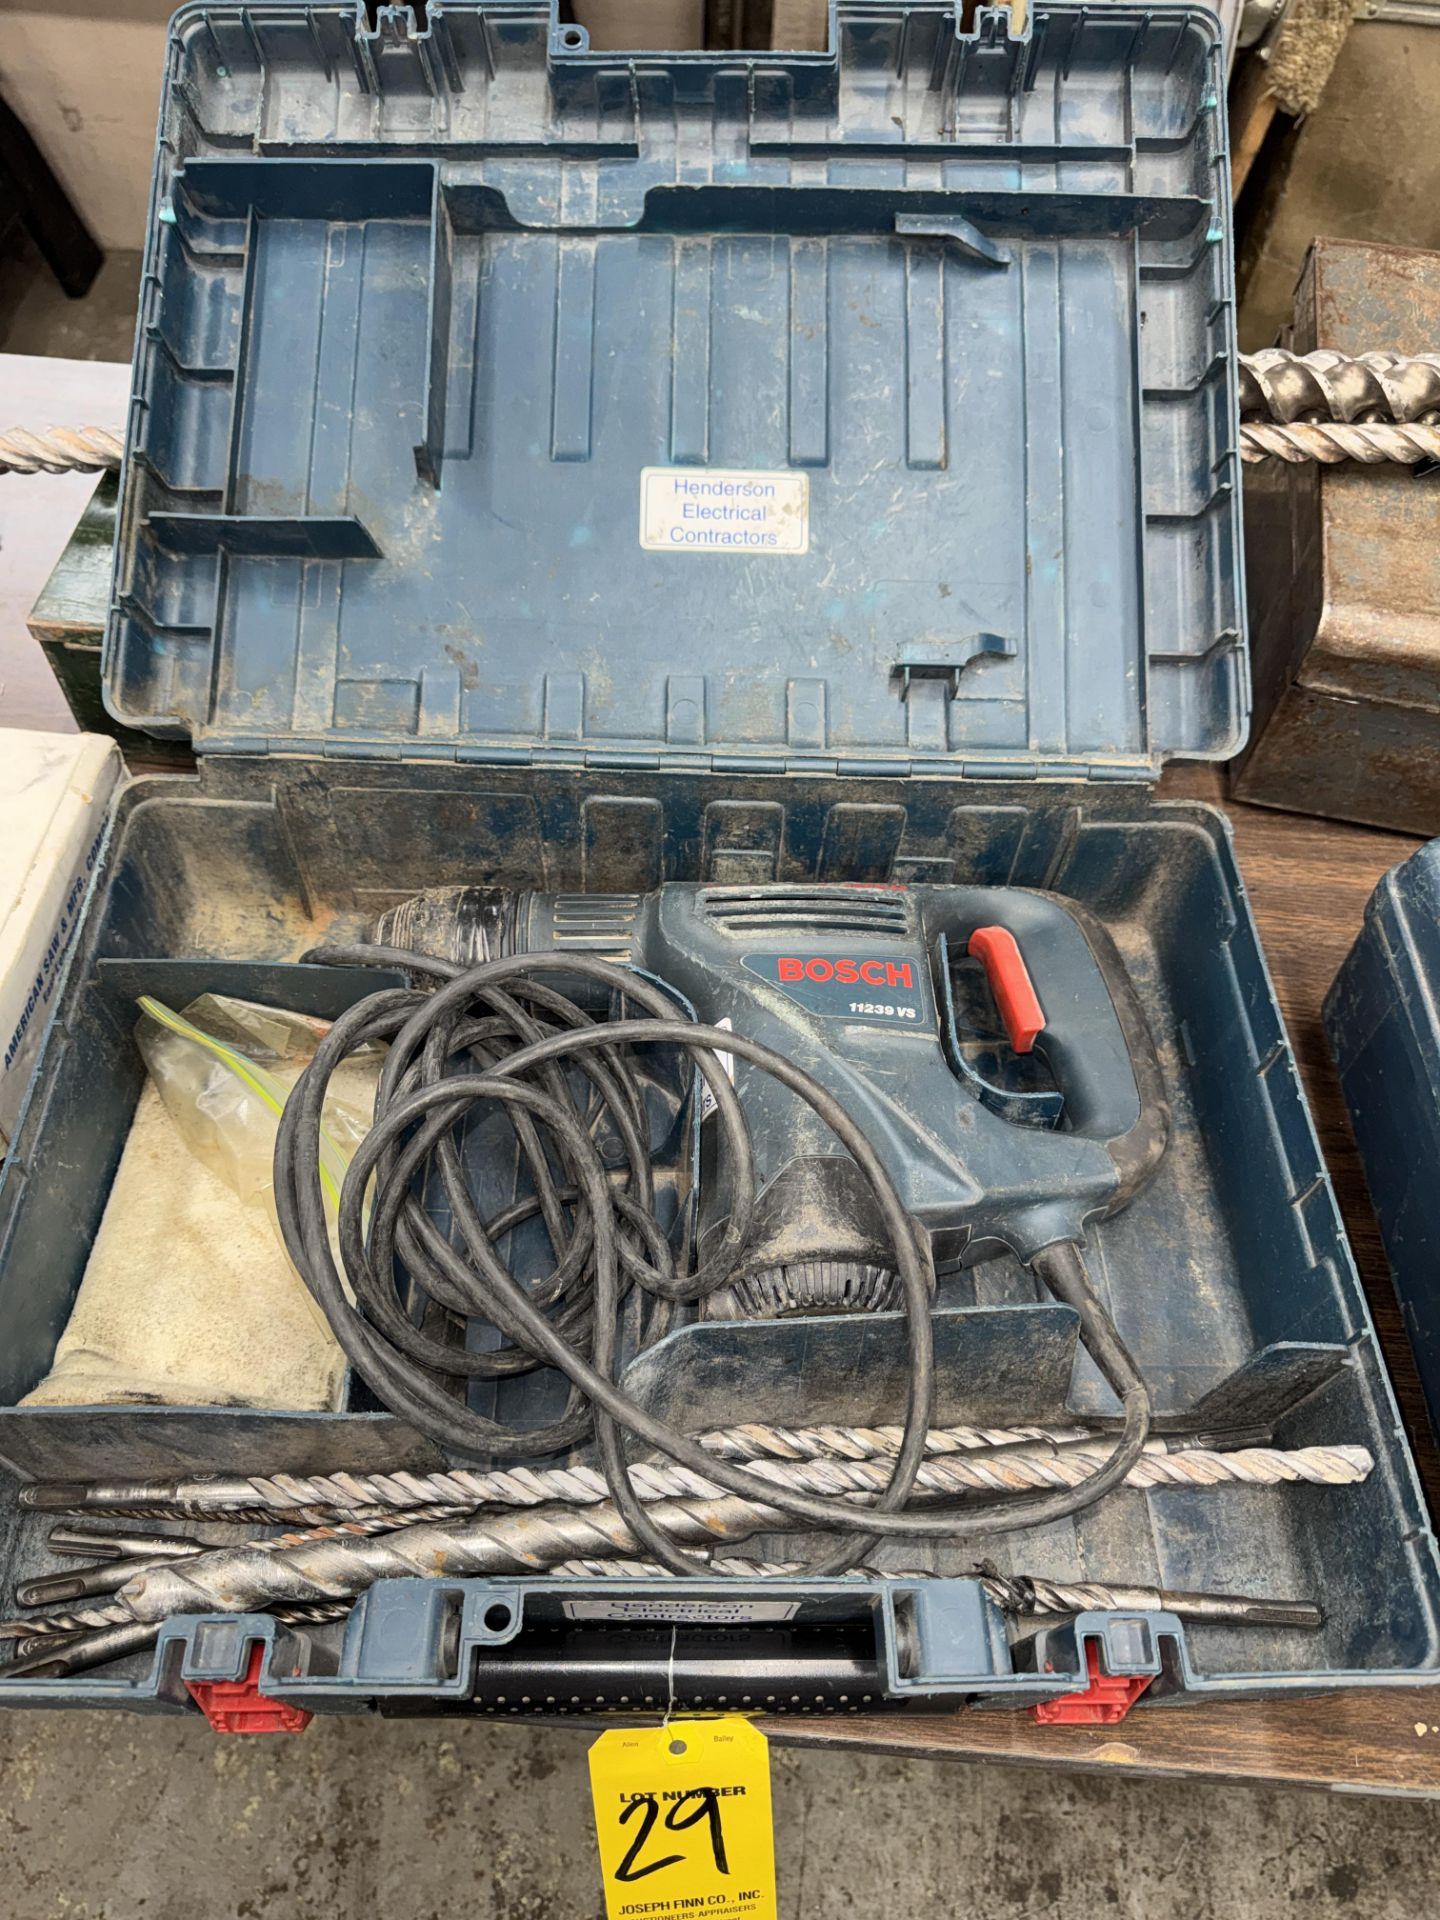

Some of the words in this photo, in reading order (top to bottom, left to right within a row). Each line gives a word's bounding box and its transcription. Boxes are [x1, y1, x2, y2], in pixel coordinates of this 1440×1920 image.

[674, 478, 776, 497] Henderson
[682, 503, 767, 521] Electrical
[670, 526, 778, 546] Contractors
[777, 957, 913, 988] BOSCH
[3, 972, 45, 1071] AMERICAN
[43, 933, 61, 974] SAW
[61, 917, 68, 934] &
[849, 1002, 895, 1016] 11239
[896, 1006, 917, 1019] VS
[607, 1612, 753, 1620] Contractors
[713, 1735, 734, 1743] Bailey
[619, 1792, 658, 1803] LOT
[614, 1787, 731, 1882] 29
[618, 1900, 671, 1915] JOSEPH
[673, 1896, 705, 1909] FINN
[738, 1889, 765, 1901] INC.
